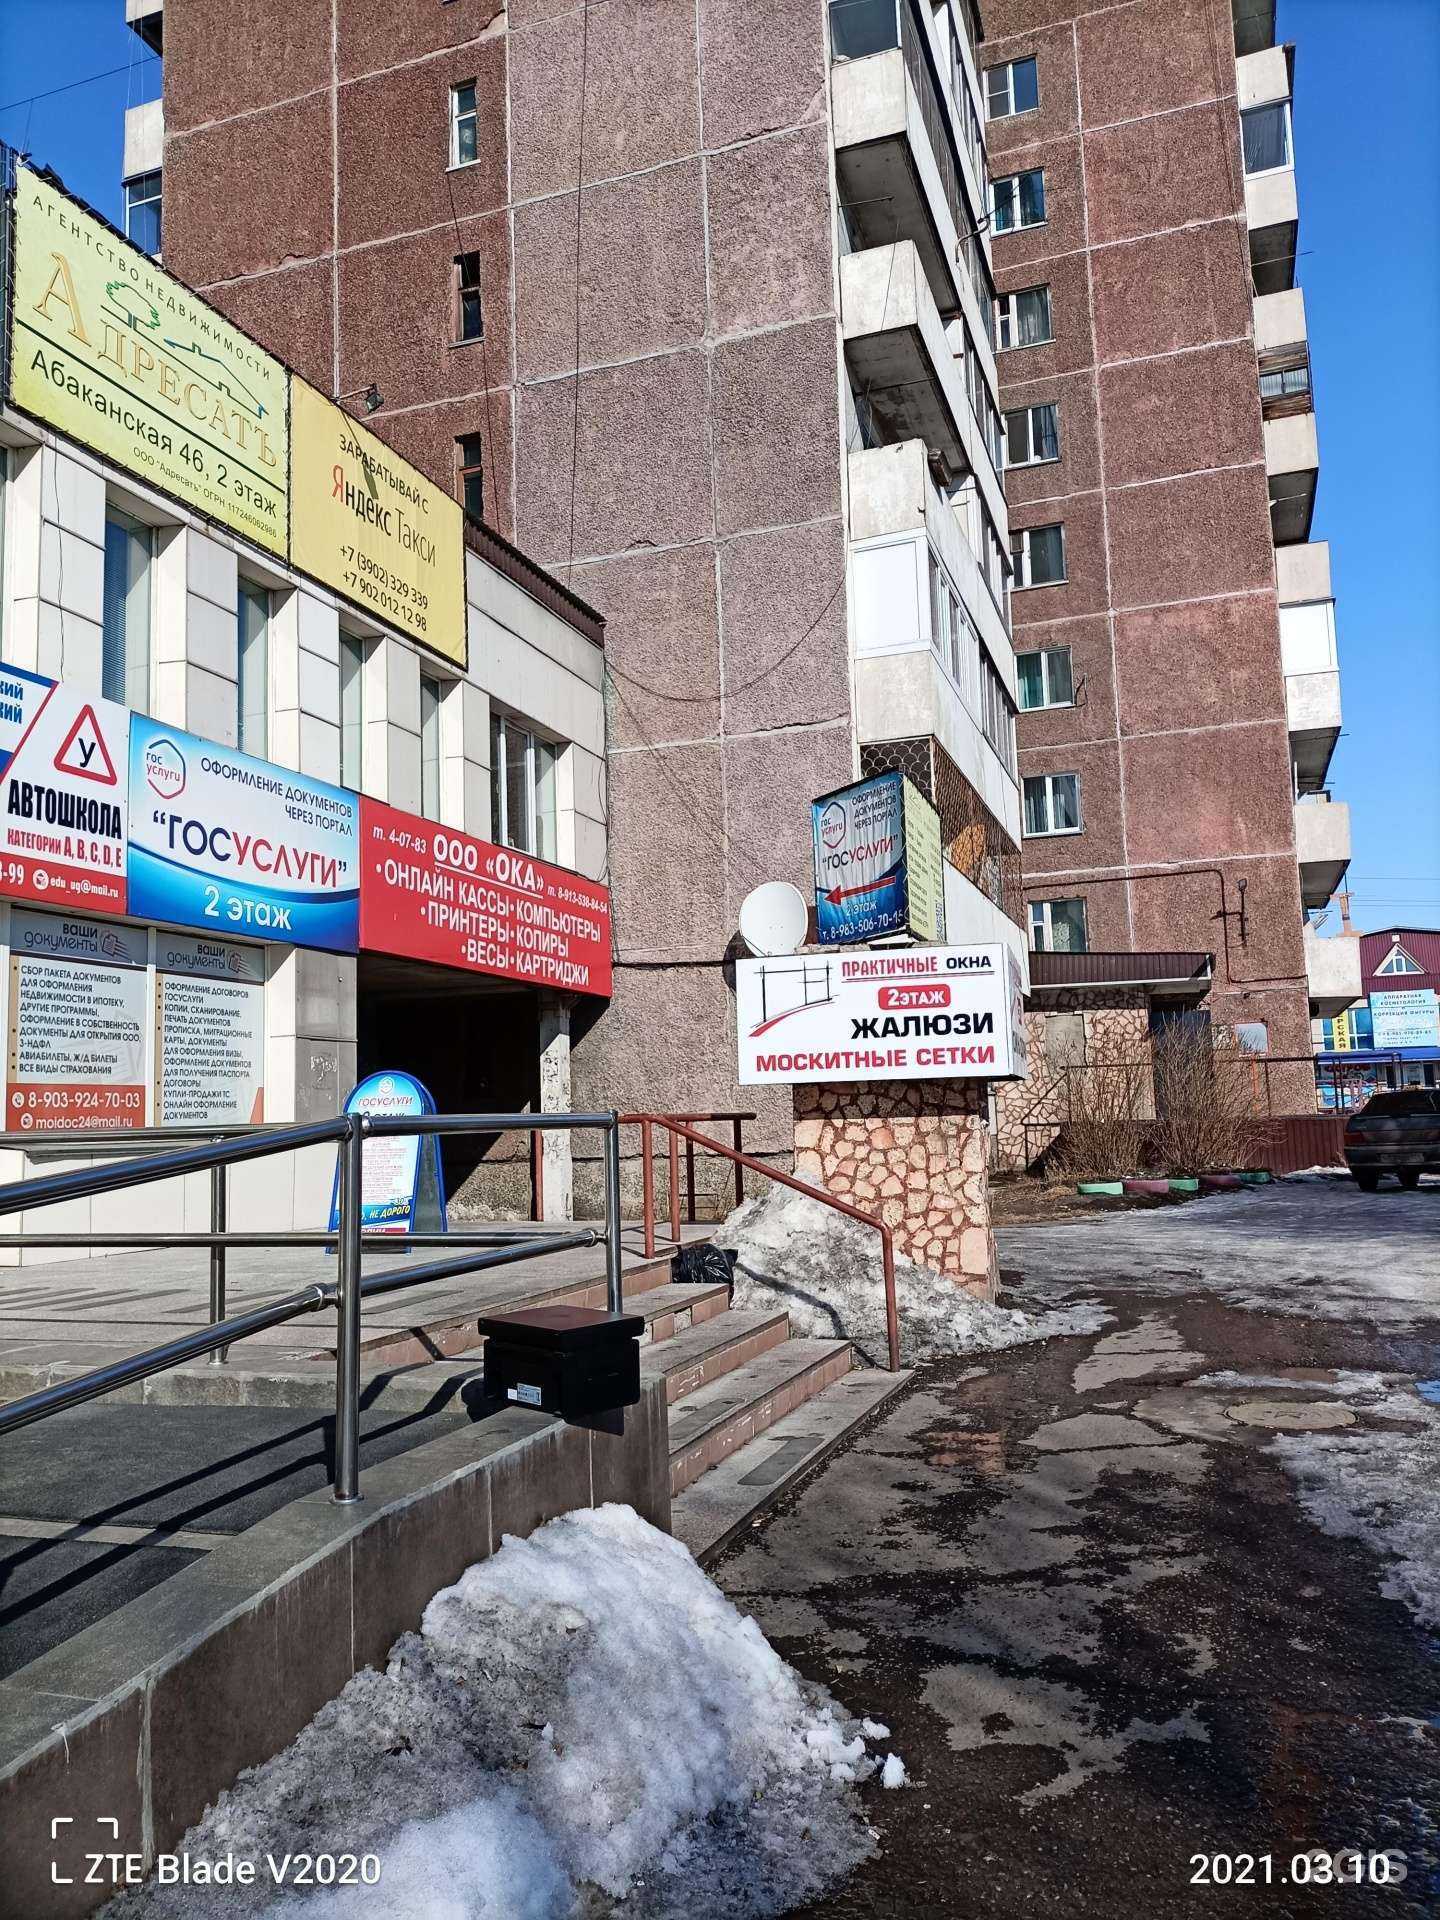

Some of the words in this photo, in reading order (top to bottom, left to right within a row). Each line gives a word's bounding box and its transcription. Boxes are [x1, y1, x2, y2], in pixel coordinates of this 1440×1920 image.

[33, 195, 139, 283] АГЕНТСТВО
[145, 278, 271, 381] НЕДВИЖИМОСТИ
[31, 349, 172, 455] Абаканская
[179, 443, 209, 481] 46,
[217, 464, 228, 489] 2
[234, 479, 277, 519] этаж
[133, 446, 155, 466] ООО
[203, 488, 225, 507] ОГРН
[339, 434, 421, 507] ЗАРАБАТЫВАЙ
[332, 464, 392, 537] Яндекс
[395, 507, 436, 568] Такси
[340, 545, 355, 562] +7
[357, 551, 389, 588] (3902)
[391, 574, 409, 598] 329
[411, 587, 429, 610] 339
[342, 571, 357, 588] +7
[359, 578, 379, 603] 902
[381, 592, 399, 616] 012
[402, 605, 414, 625] 12
[415, 612, 427, 632] 98
[146, 752, 162, 765] гос
[200, 757, 283, 797] ОФОРМЛЕНИЕ
[285, 786, 353, 819] ДОКУМЕНТОВ
[851, 781, 897, 806] ОФОРМЛЕНИЕ
[7, 778, 122, 840] АВТОШКОЛА
[853, 795, 897, 820] ДОКУМЕНТОВ
[285, 804, 314, 826] ЧЕРЕЗ
[315, 812, 353, 837] ПОРТАЛ
[854, 817, 872, 831] ЧЕРЕЗ
[872, 808, 898, 824] ПОРТАЛ
[7, 828, 61, 855] КАТЕГОРИИ
[116, 847, 122, 868] E
[389, 831, 427, 854] 4-07-83
[433, 834, 478, 872] ООО
[486, 852, 544, 892] «ОКА»
[204, 885, 220, 917] 2
[227, 899, 293, 931] этаж
[384, 859, 454, 901] ОНЛАЙН
[458, 881, 509, 918] КАССЫ
[517, 900, 601, 943] КОМПЬЮТЕРЫ
[853, 902, 877, 913] этаж
[63, 923, 98, 938] ваши
[428, 901, 509, 944] ПРИНТЕРЫ
[517, 925, 569, 957] КОПИРЫ
[24, 931, 98, 953] документы
[197, 944, 226, 958] ваши
[167, 951, 226, 970] документы
[467, 939, 509, 970] ВЕСЫ
[517, 951, 589, 986] КАРТРИДЖИ
[841, 956, 938, 977] ПРАКТИЧНЫЕ
[946, 956, 992, 970] ОКНА
[21, 965, 43, 975] СБОР
[44, 968, 71, 979] ПАКЕТА
[73, 972, 122, 985] ДОКУМЕНТОВ
[20, 978, 37, 987] ДЛЯ
[39, 979, 93, 993] ОФОРМЛЕНИЯ
[164, 982, 211, 995] ОФОРМЛЕНИЕ
[211, 988, 249, 999] ДОГОВОРОВ
[20, 990, 85, 1004] НЕДВИЖИМОСТИ
[87, 996, 92, 1004] В
[93, 997, 125, 1008] ИПОТЕКУ,
[20, 1002, 49, 1013] ДРУГИЕ
[164, 993, 204, 1004] ГОСУСЛУГИ
[20, 1014, 75, 1027] ОФОРМЛЕНИЕ
[76, 1019, 80, 1027] В
[81, 1019, 140, 1031] СОБСТВЕННОСТЬ
[164, 1014, 187, 1024] ПЕЧАТЬ
[188, 1016, 231, 1027] ДОКУМЕНТОВ
[850, 1012, 994, 1040] ЖАЛЮЗИ
[20, 1027, 68, 1038] ДОКУМЕНТЫ
[69, 1030, 86, 1039] ДЛЯ
[86, 1031, 121, 1041] ОТКРЫТИЯ
[203, 1028, 252, 1039] МИГРАЦИОННЫЕ
[1337, 1014, 1347, 1049] РСКАЯ
[164, 1047, 178, 1055] ДЛЯ
[180, 1047, 225, 1057] ОФОРМЛЕНИЯ
[188, 1037, 227, 1047] ДОКУМЕНТЫ
[20, 1063, 34, 1073] ВСЕ
[36, 1064, 58, 1074] ВИДЫ
[60, 1065, 112, 1075] СТРАХОВАНИЯ
[74, 1054, 90, 1063] Ж/Д
[91, 1055, 118, 1064] БИЛЕТЫ
[164, 1057, 210, 1067] ОФОРМЛЕНИЕ
[211, 1059, 252, 1068] ДОКУМЕНТОВ
[756, 1052, 908, 1073] МОСКИТНЫЕ
[916, 1045, 995, 1066] СЕТКИ
[164, 1068, 178, 1077] ДЛЯ
[180, 1069, 218, 1078] ПОЛУЧЕНИЯ
[218, 1070, 250, 1078] ПАСПОРТА
[164, 1079, 201, 1088] ДОГОВОРЫ
[28, 1092, 140, 1109] 8-903-924-70-03
[163, 1099, 192, 1109] ОНЛАЙН
[193, 1101, 237, 1109] ОФОРМЛЕНИЕ
[164, 1090, 222, 1099] КУПЛИ-ПРОДАЖИ
[163, 1111, 208, 1120] ДОКУМЕНТОВ
